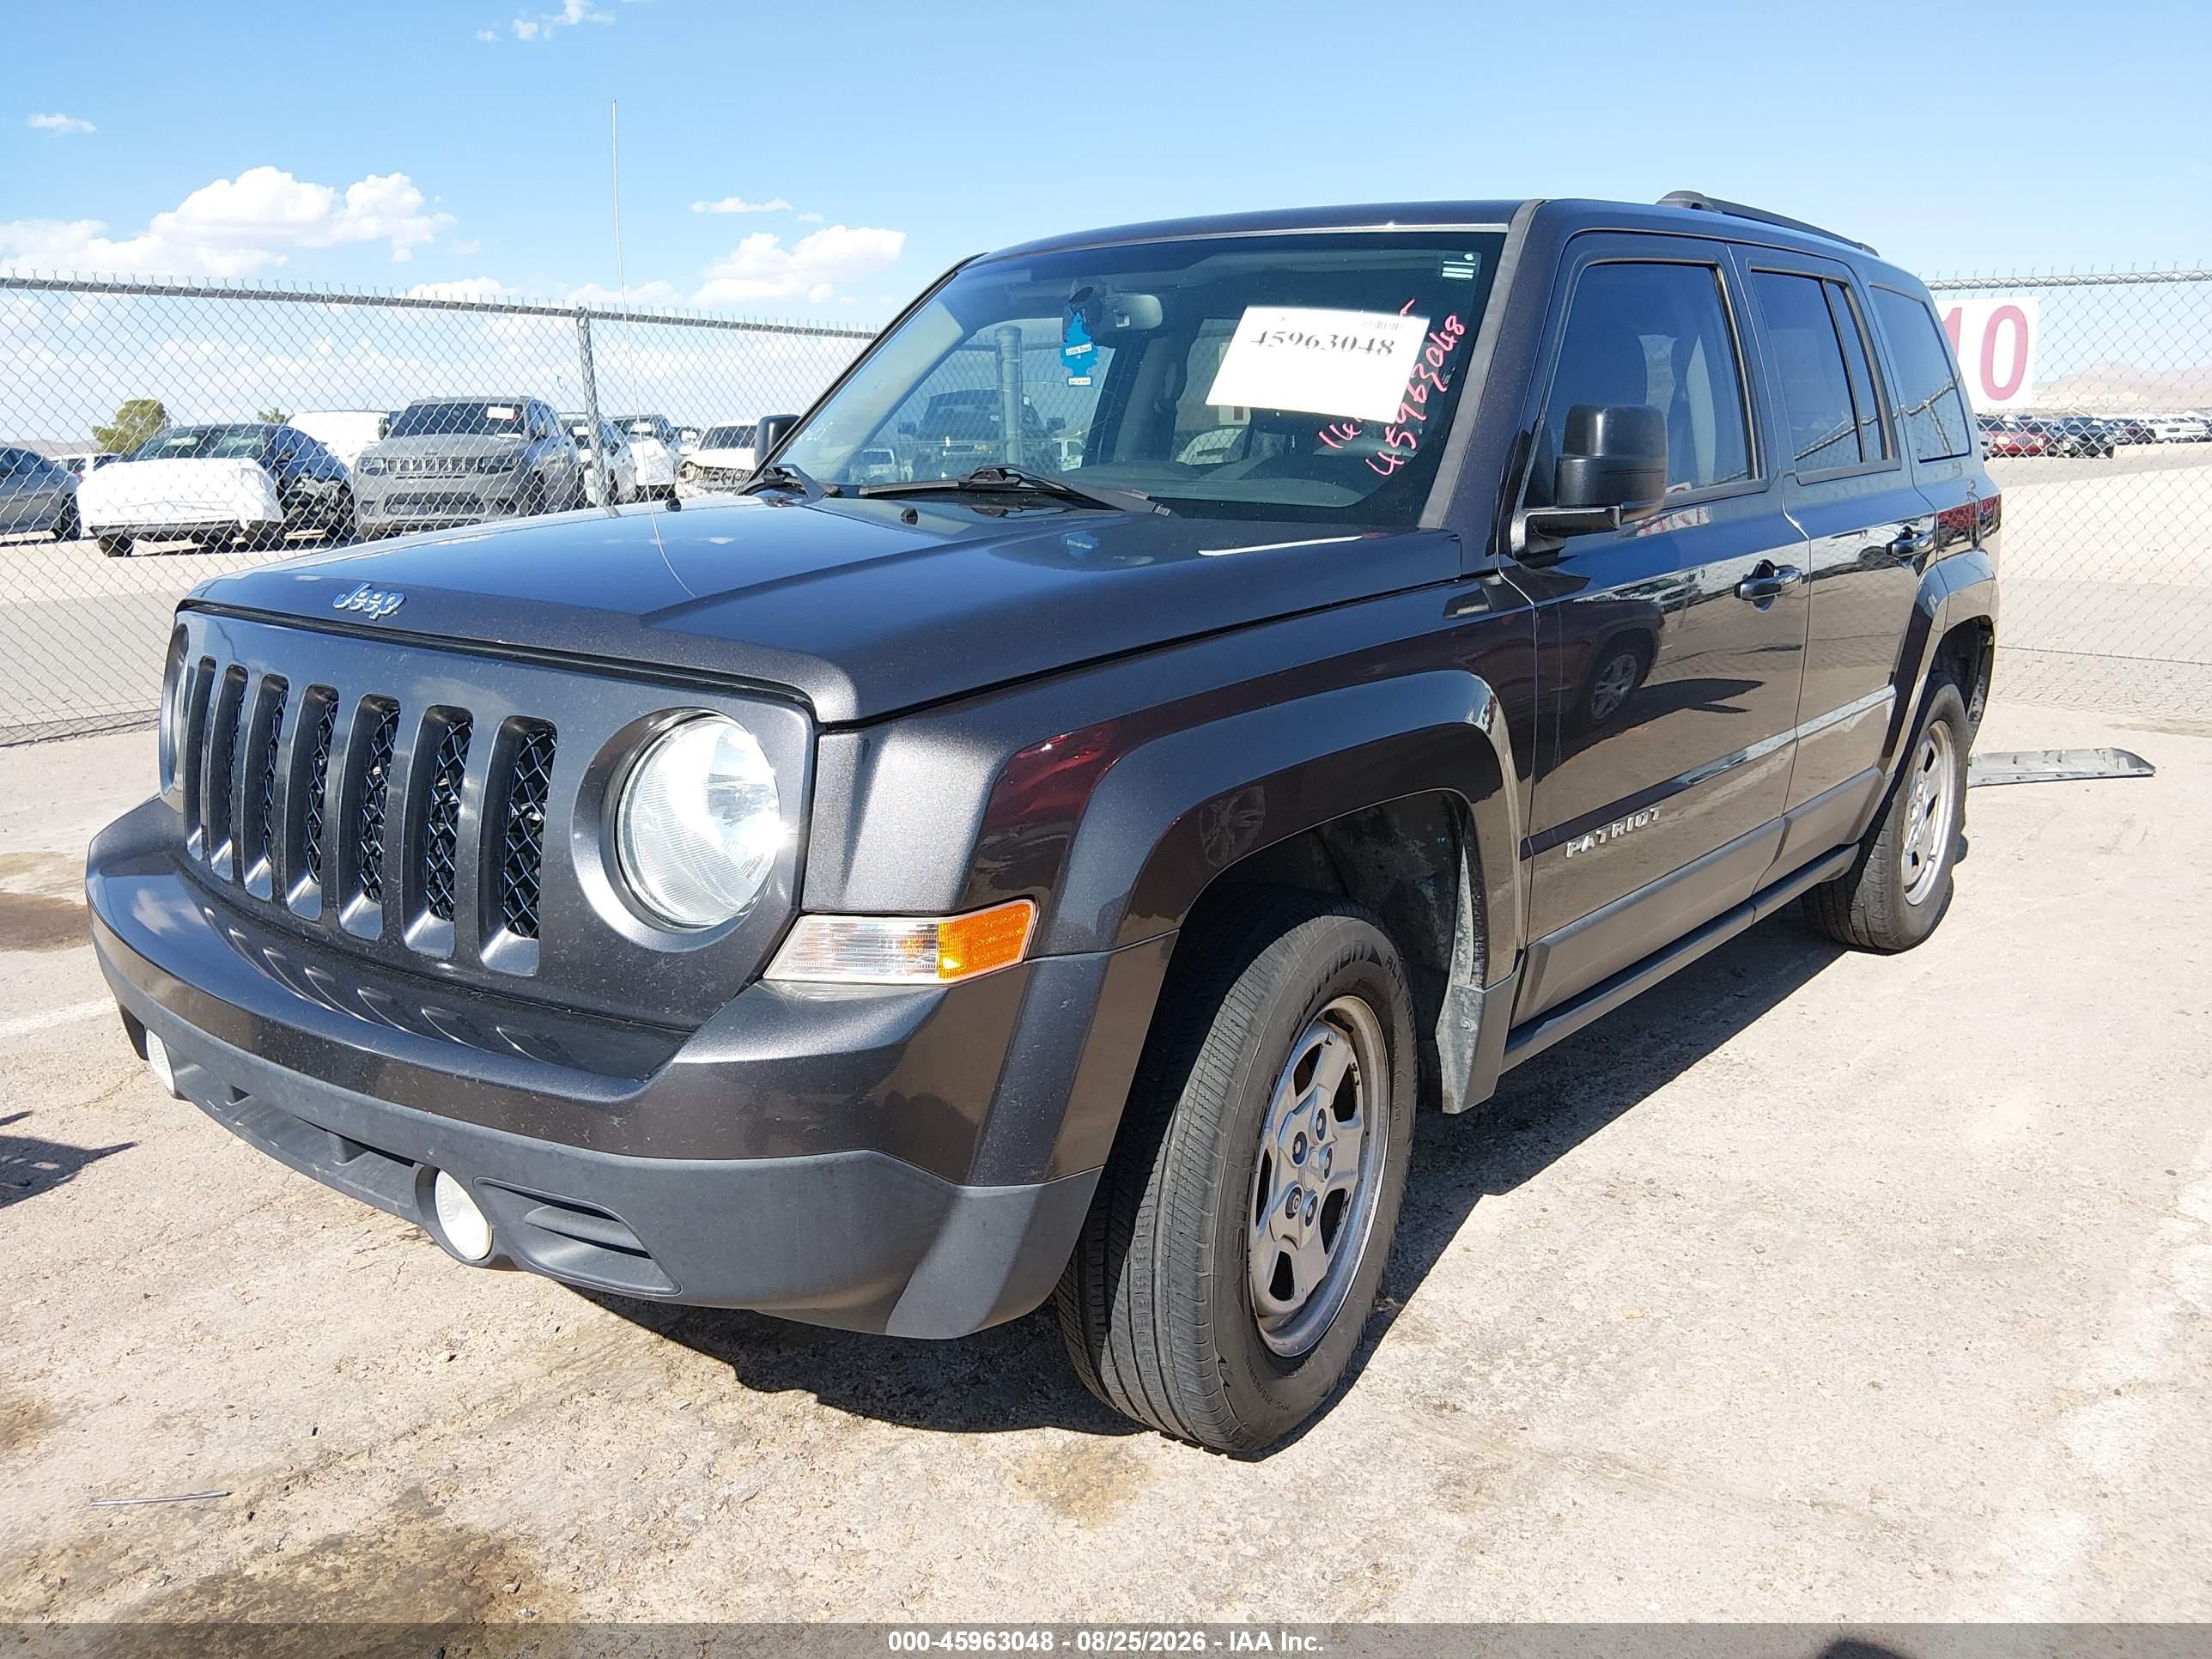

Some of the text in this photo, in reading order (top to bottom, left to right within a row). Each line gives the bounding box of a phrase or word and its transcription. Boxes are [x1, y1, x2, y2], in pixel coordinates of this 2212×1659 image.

[1250, 328, 1395, 358] 45963048
[1365, 313, 1465, 476] 45963048
[332, 582, 406, 620] Jeep
[1565, 805, 1662, 859] PATRIOT
[1384, 954, 1403, 990] ALL
